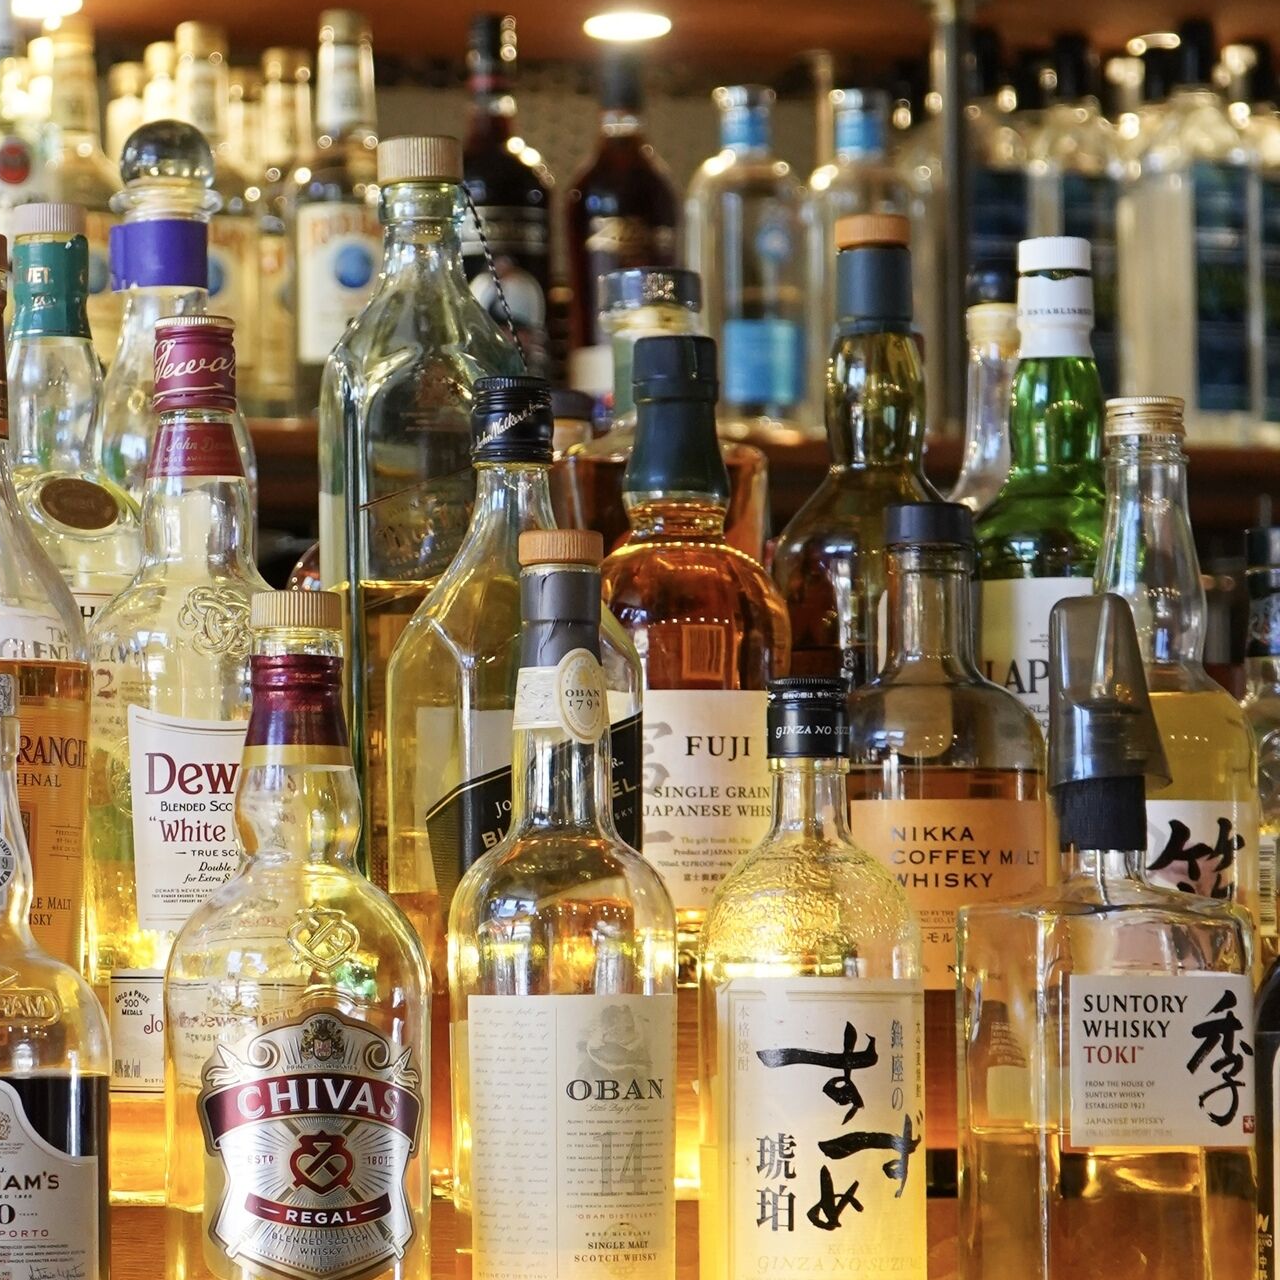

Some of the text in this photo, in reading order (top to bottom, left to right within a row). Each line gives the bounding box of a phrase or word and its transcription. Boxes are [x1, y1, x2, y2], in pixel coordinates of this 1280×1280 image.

[565, 688, 601, 698] OBAN
[776, 726, 831, 739] GINZA NO
[685, 735, 751, 762] FUJI
[654, 785, 719, 798] SINGLE
[726, 785, 770, 799] GRAIN
[160, 800, 206, 812] BLENDED
[642, 804, 732, 817] JAPANESE
[892, 827, 974, 841] NIKKA
[710, 848, 730, 856] JAPAN
[893, 850, 1040, 865] COFFEY MALT
[198, 862, 231, 872] Double
[182, 874, 221, 885] for Extra
[895, 872, 993, 888] WHISKY
[47, 896, 72, 911] MALT
[124, 999, 139, 1008] 500
[1083, 995, 1188, 1013] SUNTORY
[1083, 1020, 1170, 1038] WHISKY
[566, 1078, 665, 1101] OBAN
[1085, 1080, 1156, 1088] FROM THE HOUSE OF
[236, 1078, 402, 1122] CHIVAS
[1085, 1091, 1146, 1099] SUNTORY WHISKY
[1085, 1102, 1129, 1110] ESTABLISHED
[1085, 1116, 1165, 1125] JAPANESE WHISKY
[756, 1133, 797, 1232] 琥珀
[285, 1209, 357, 1224] REGAL
[271, 1232, 370, 1245] BLENDED SCOTCH
[587, 1240, 648, 1250] SINGLE MALT
[299, 1248, 343, 1256] WHISKY
[574, 1253, 657, 1263] SCOTCH WHISKY
